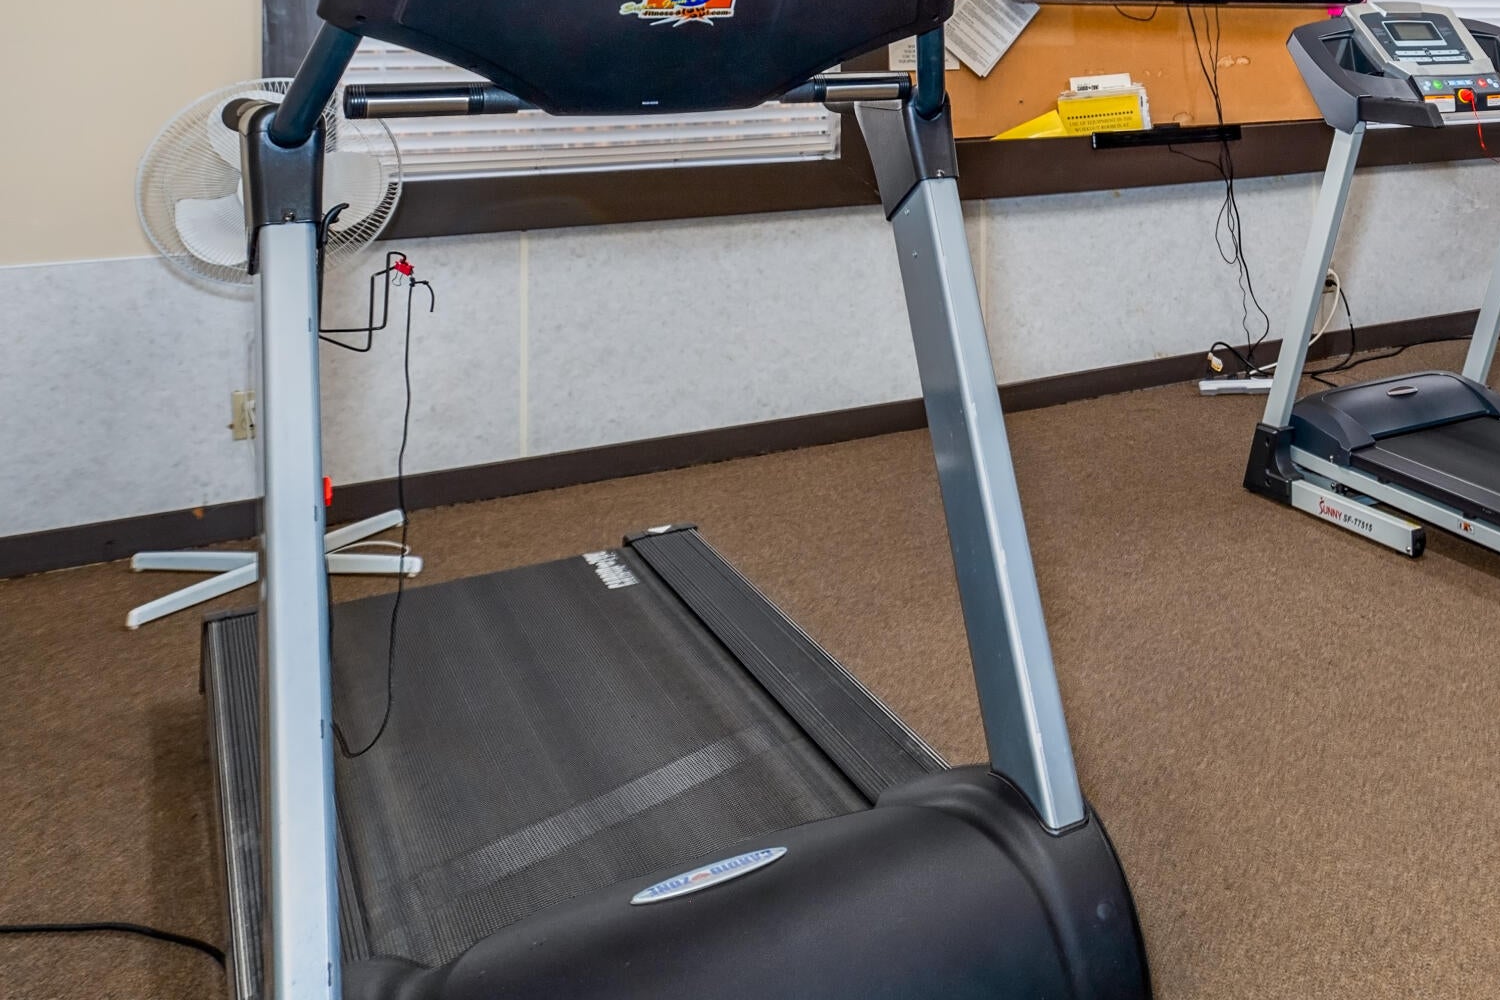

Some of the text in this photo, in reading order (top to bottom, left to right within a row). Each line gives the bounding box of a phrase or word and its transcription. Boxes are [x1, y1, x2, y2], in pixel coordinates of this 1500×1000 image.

[1319, 497, 1342, 521] SUNNY
[648, 849, 772, 897] CARDIO ZONE
